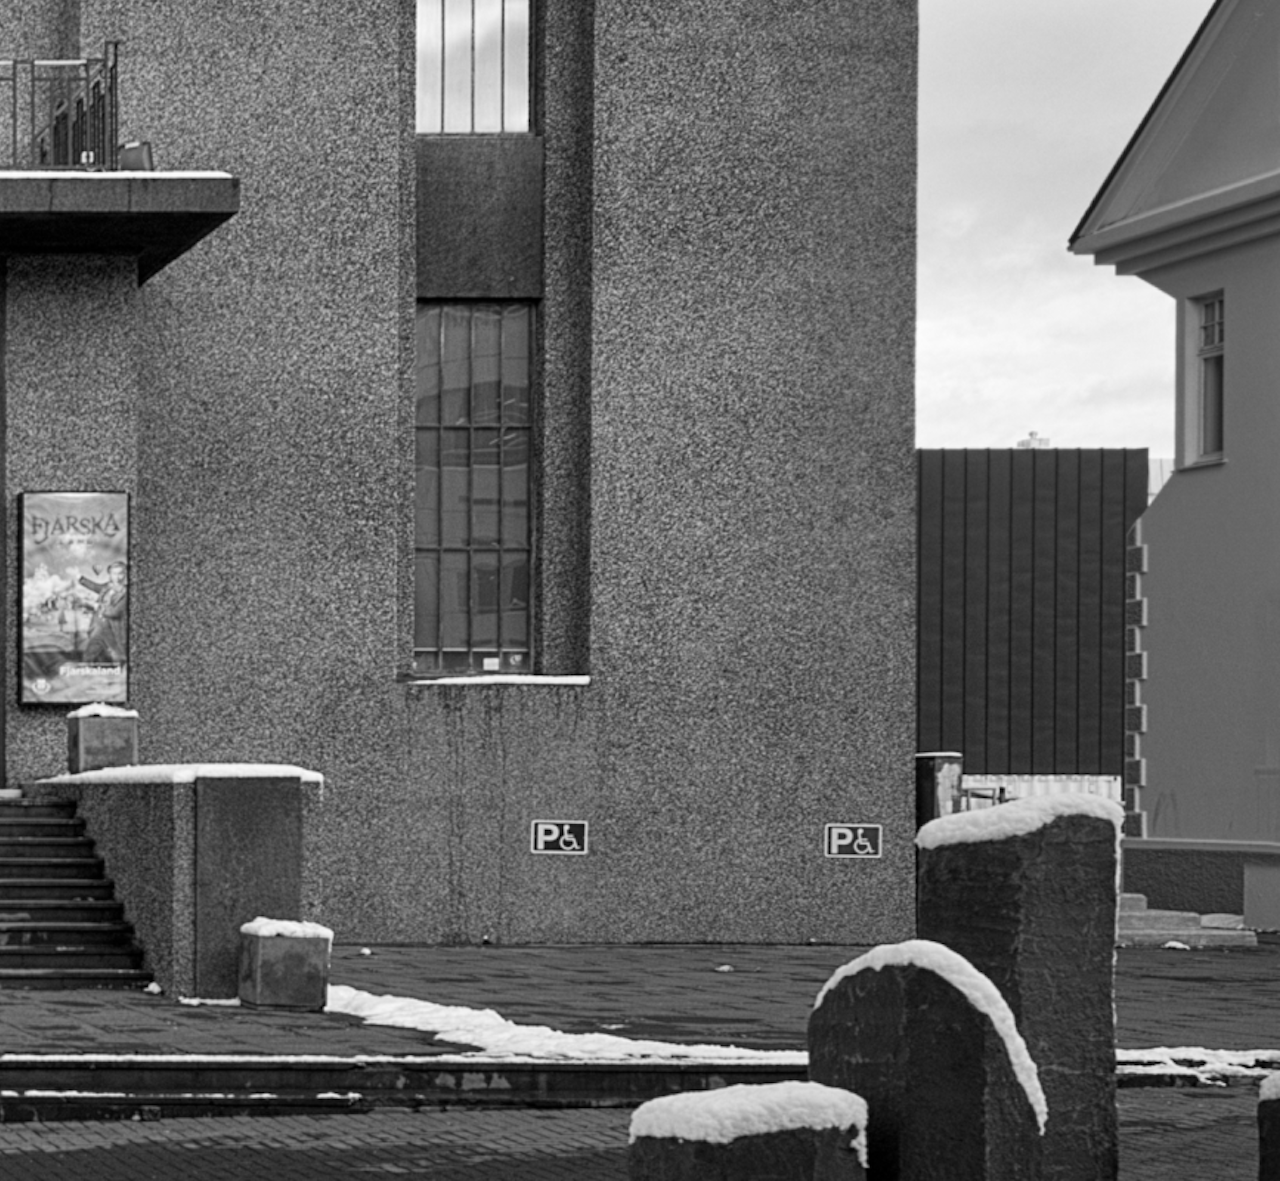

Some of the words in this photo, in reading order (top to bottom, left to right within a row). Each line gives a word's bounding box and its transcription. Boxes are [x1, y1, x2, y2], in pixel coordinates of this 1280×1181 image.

[32, 512, 120, 544] FJARSKA
[60, 666, 120, 677] Fjarskaland
[537, 824, 560, 849] P
[830, 828, 854, 853] P
